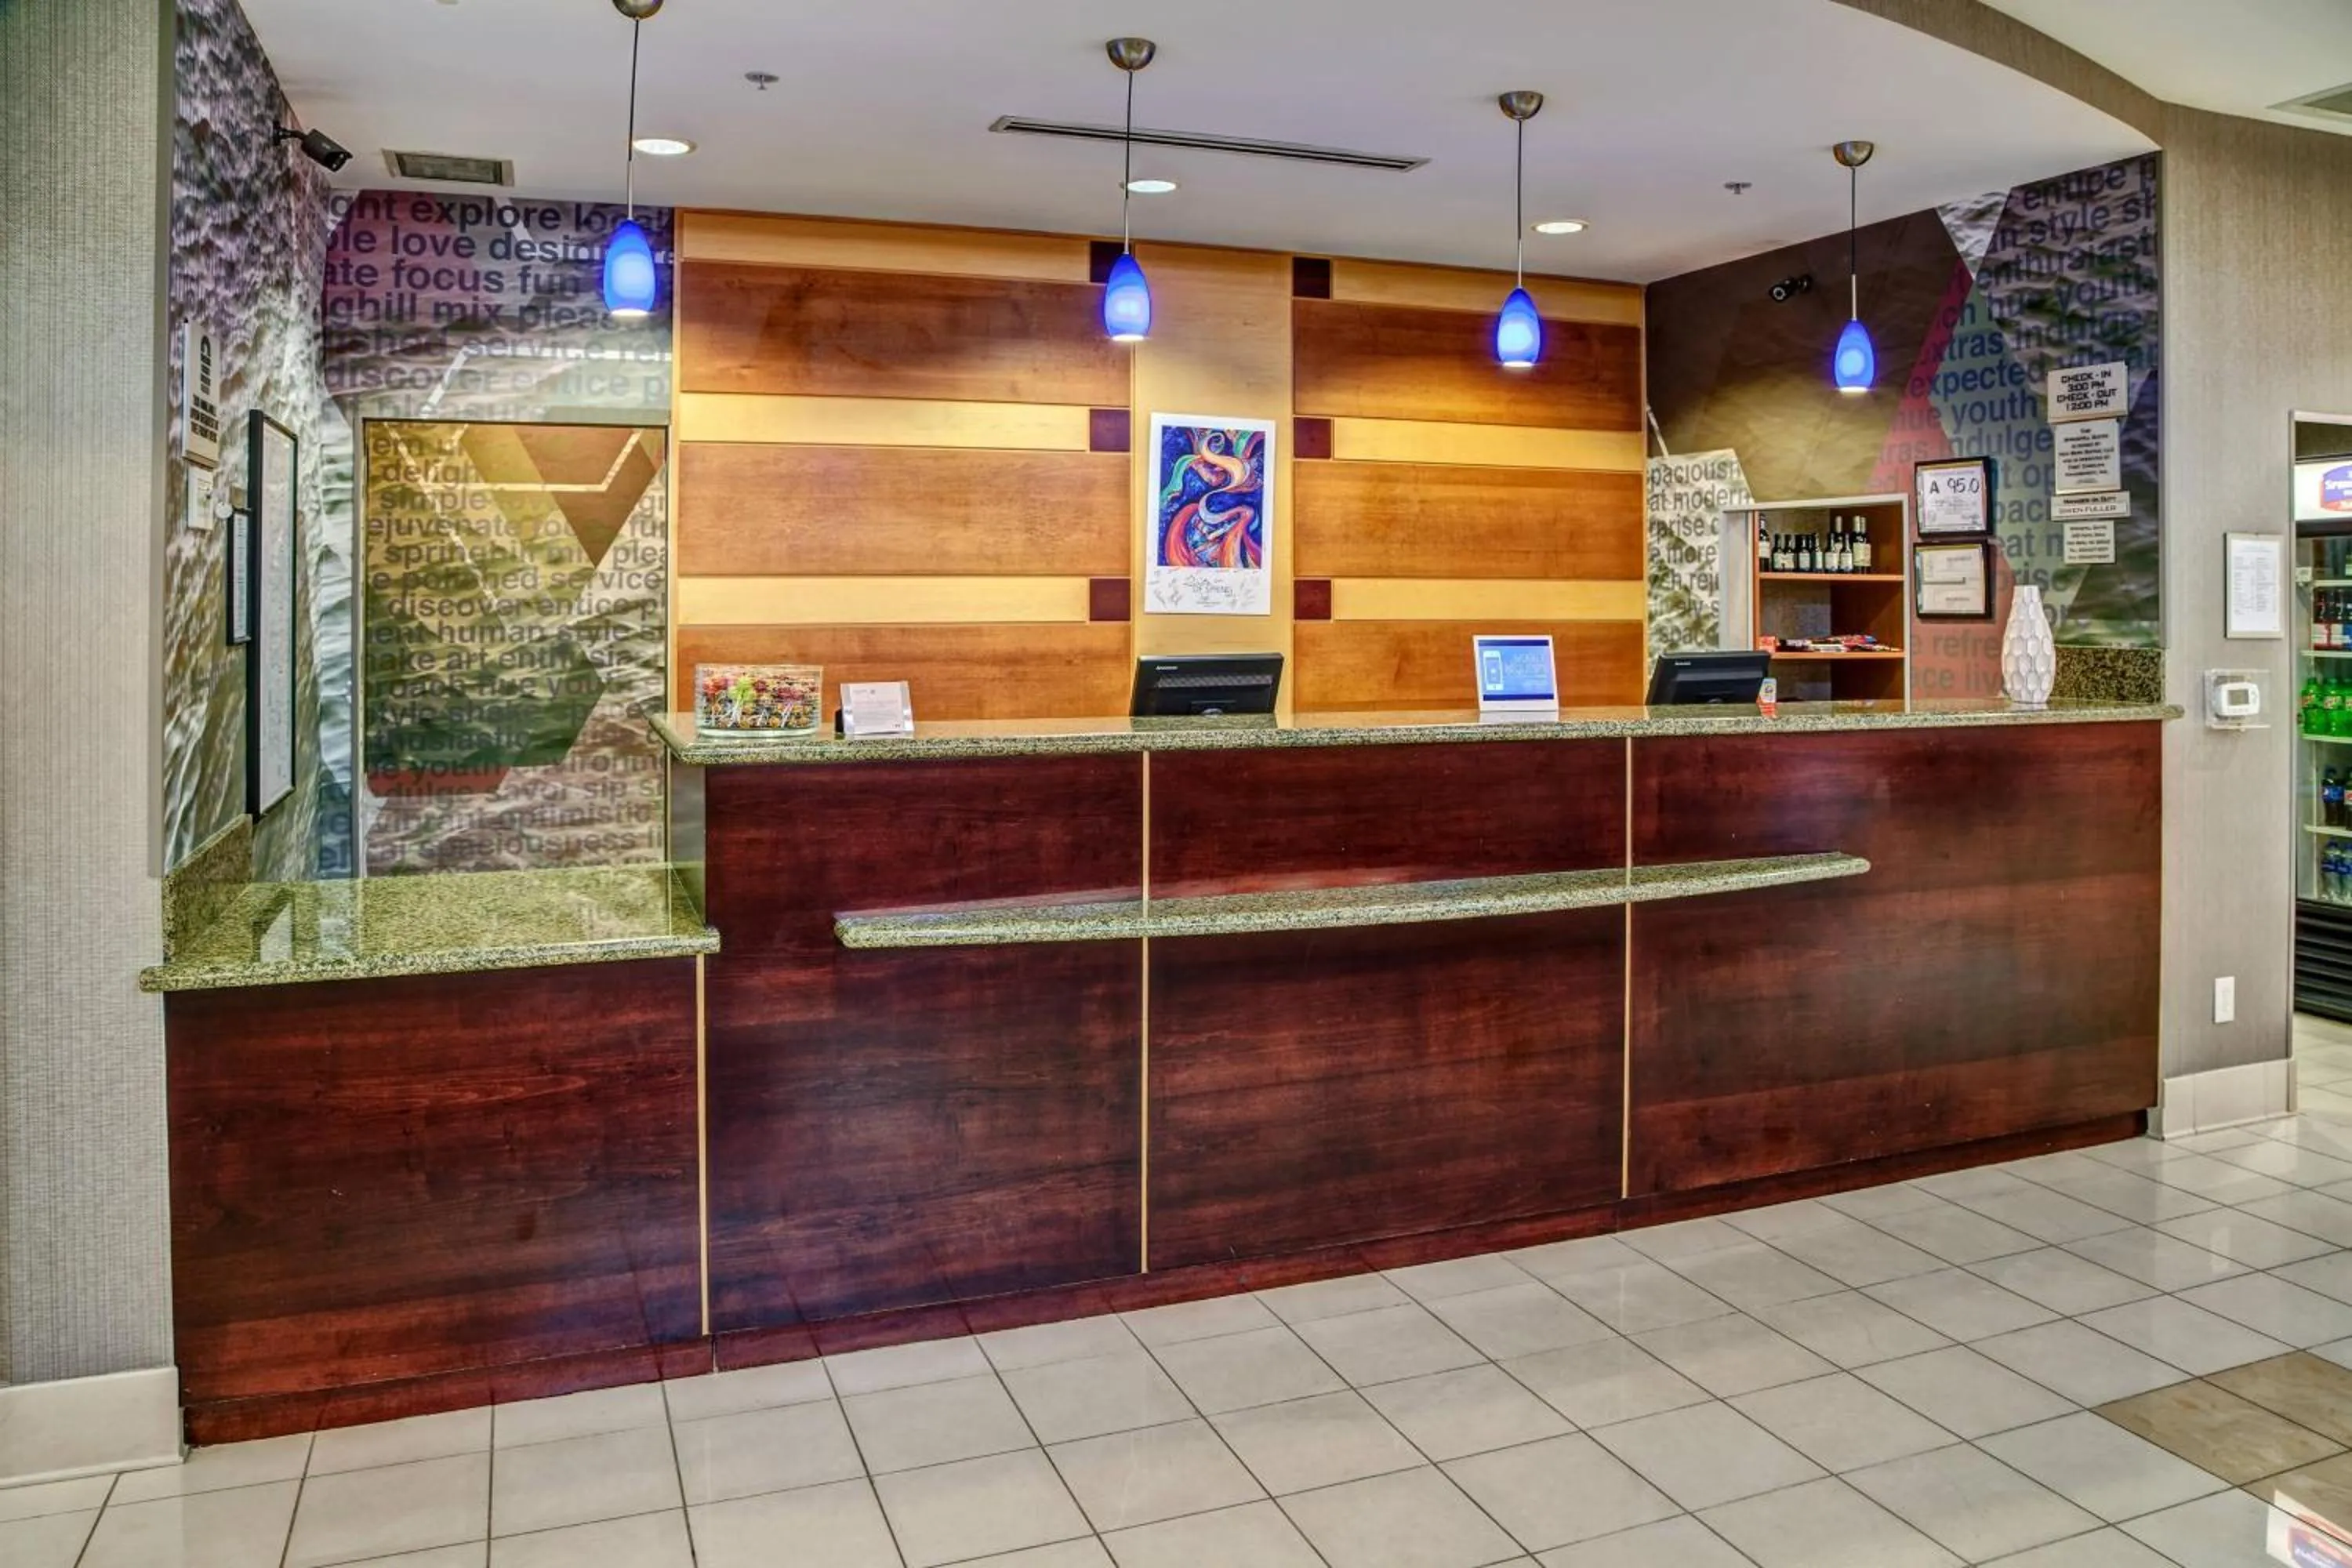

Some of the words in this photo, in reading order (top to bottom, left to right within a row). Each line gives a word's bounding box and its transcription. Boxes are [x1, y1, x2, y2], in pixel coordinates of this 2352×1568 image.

[410, 200, 561, 234] explore
[2029, 201, 2111, 245] style
[391, 226, 477, 259] love
[392, 259, 503, 294] focus
[433, 295, 506, 324] mix
[2061, 372, 2093, 383] CHECK
[2101, 369, 2111, 378] IN
[2056, 392, 2089, 403] CHECK
[2096, 388, 2117, 398] OUT
[1951, 390, 2038, 433] youth
[1929, 479, 1940, 495] A
[437, 619, 544, 644] human
